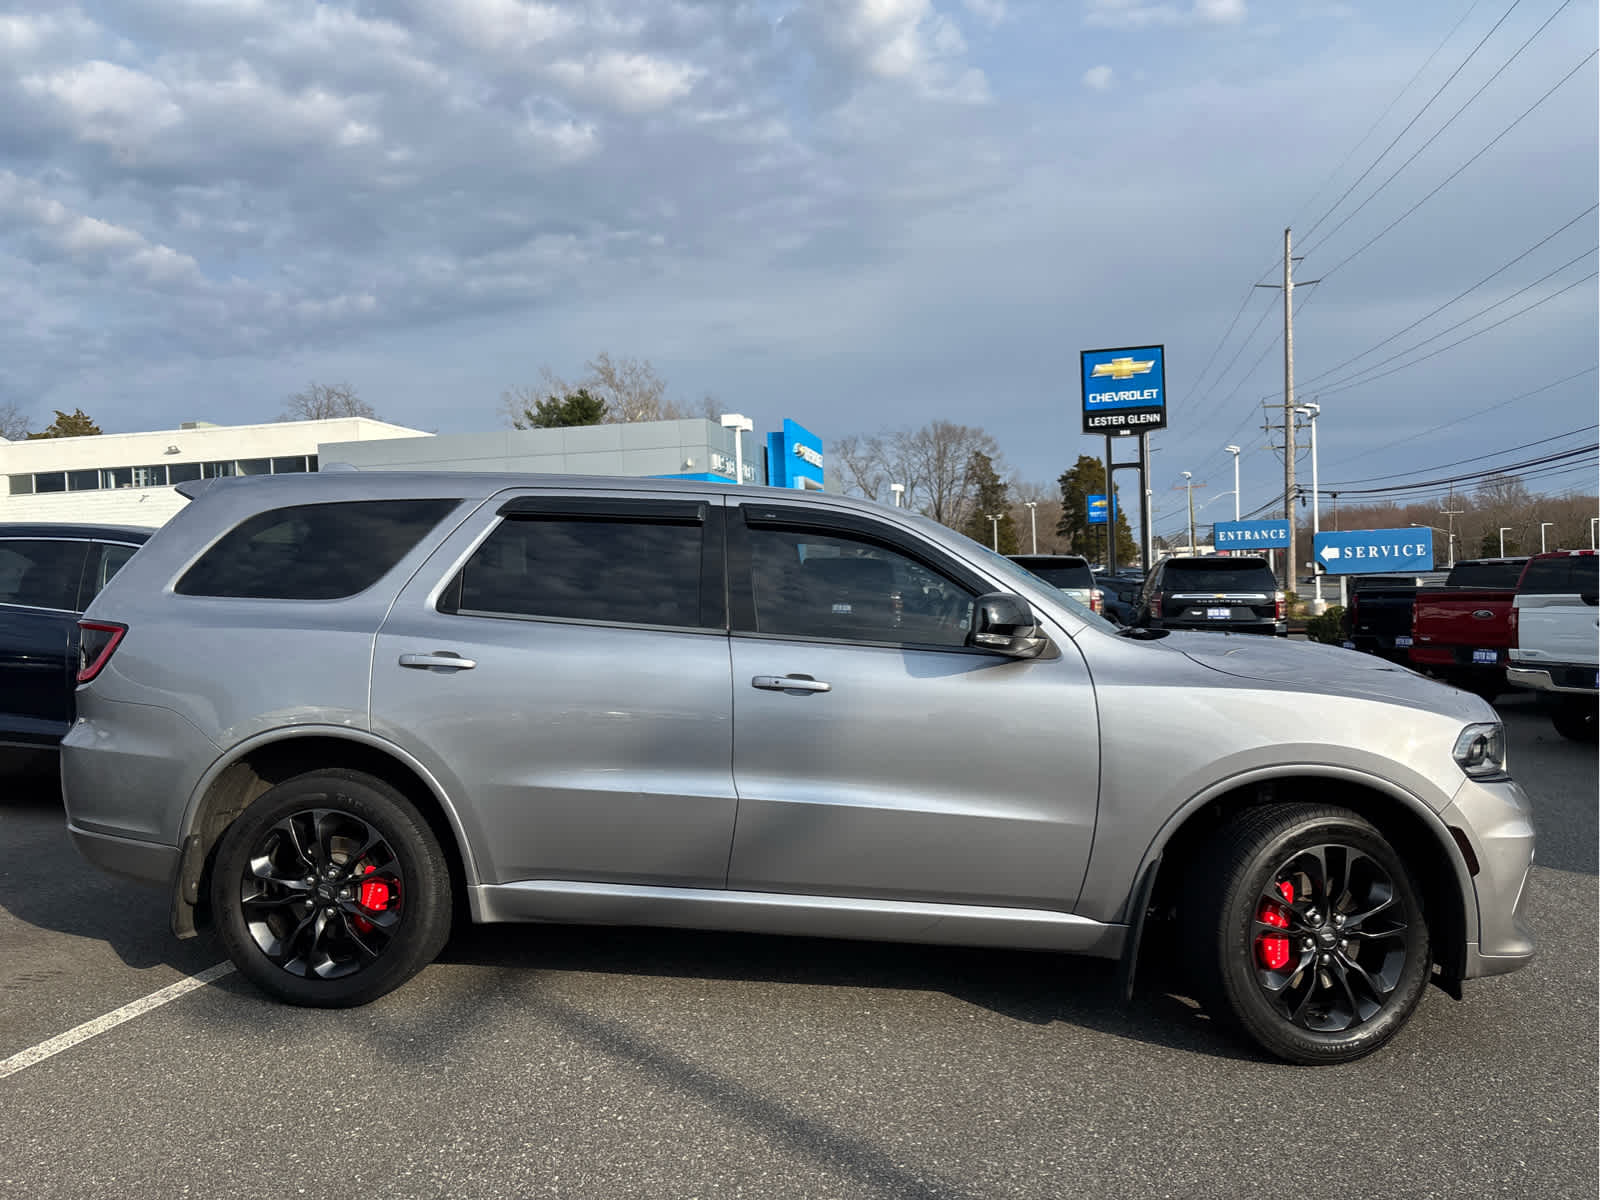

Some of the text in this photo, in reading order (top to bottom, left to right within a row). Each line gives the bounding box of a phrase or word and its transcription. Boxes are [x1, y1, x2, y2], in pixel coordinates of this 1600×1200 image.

[1088, 389, 1159, 403] CHEVROLET
[1088, 414, 1161, 427] LESTER GLENN
[1219, 529, 1286, 541] ENTRANCE
[1344, 544, 1426, 559] SERVICE
